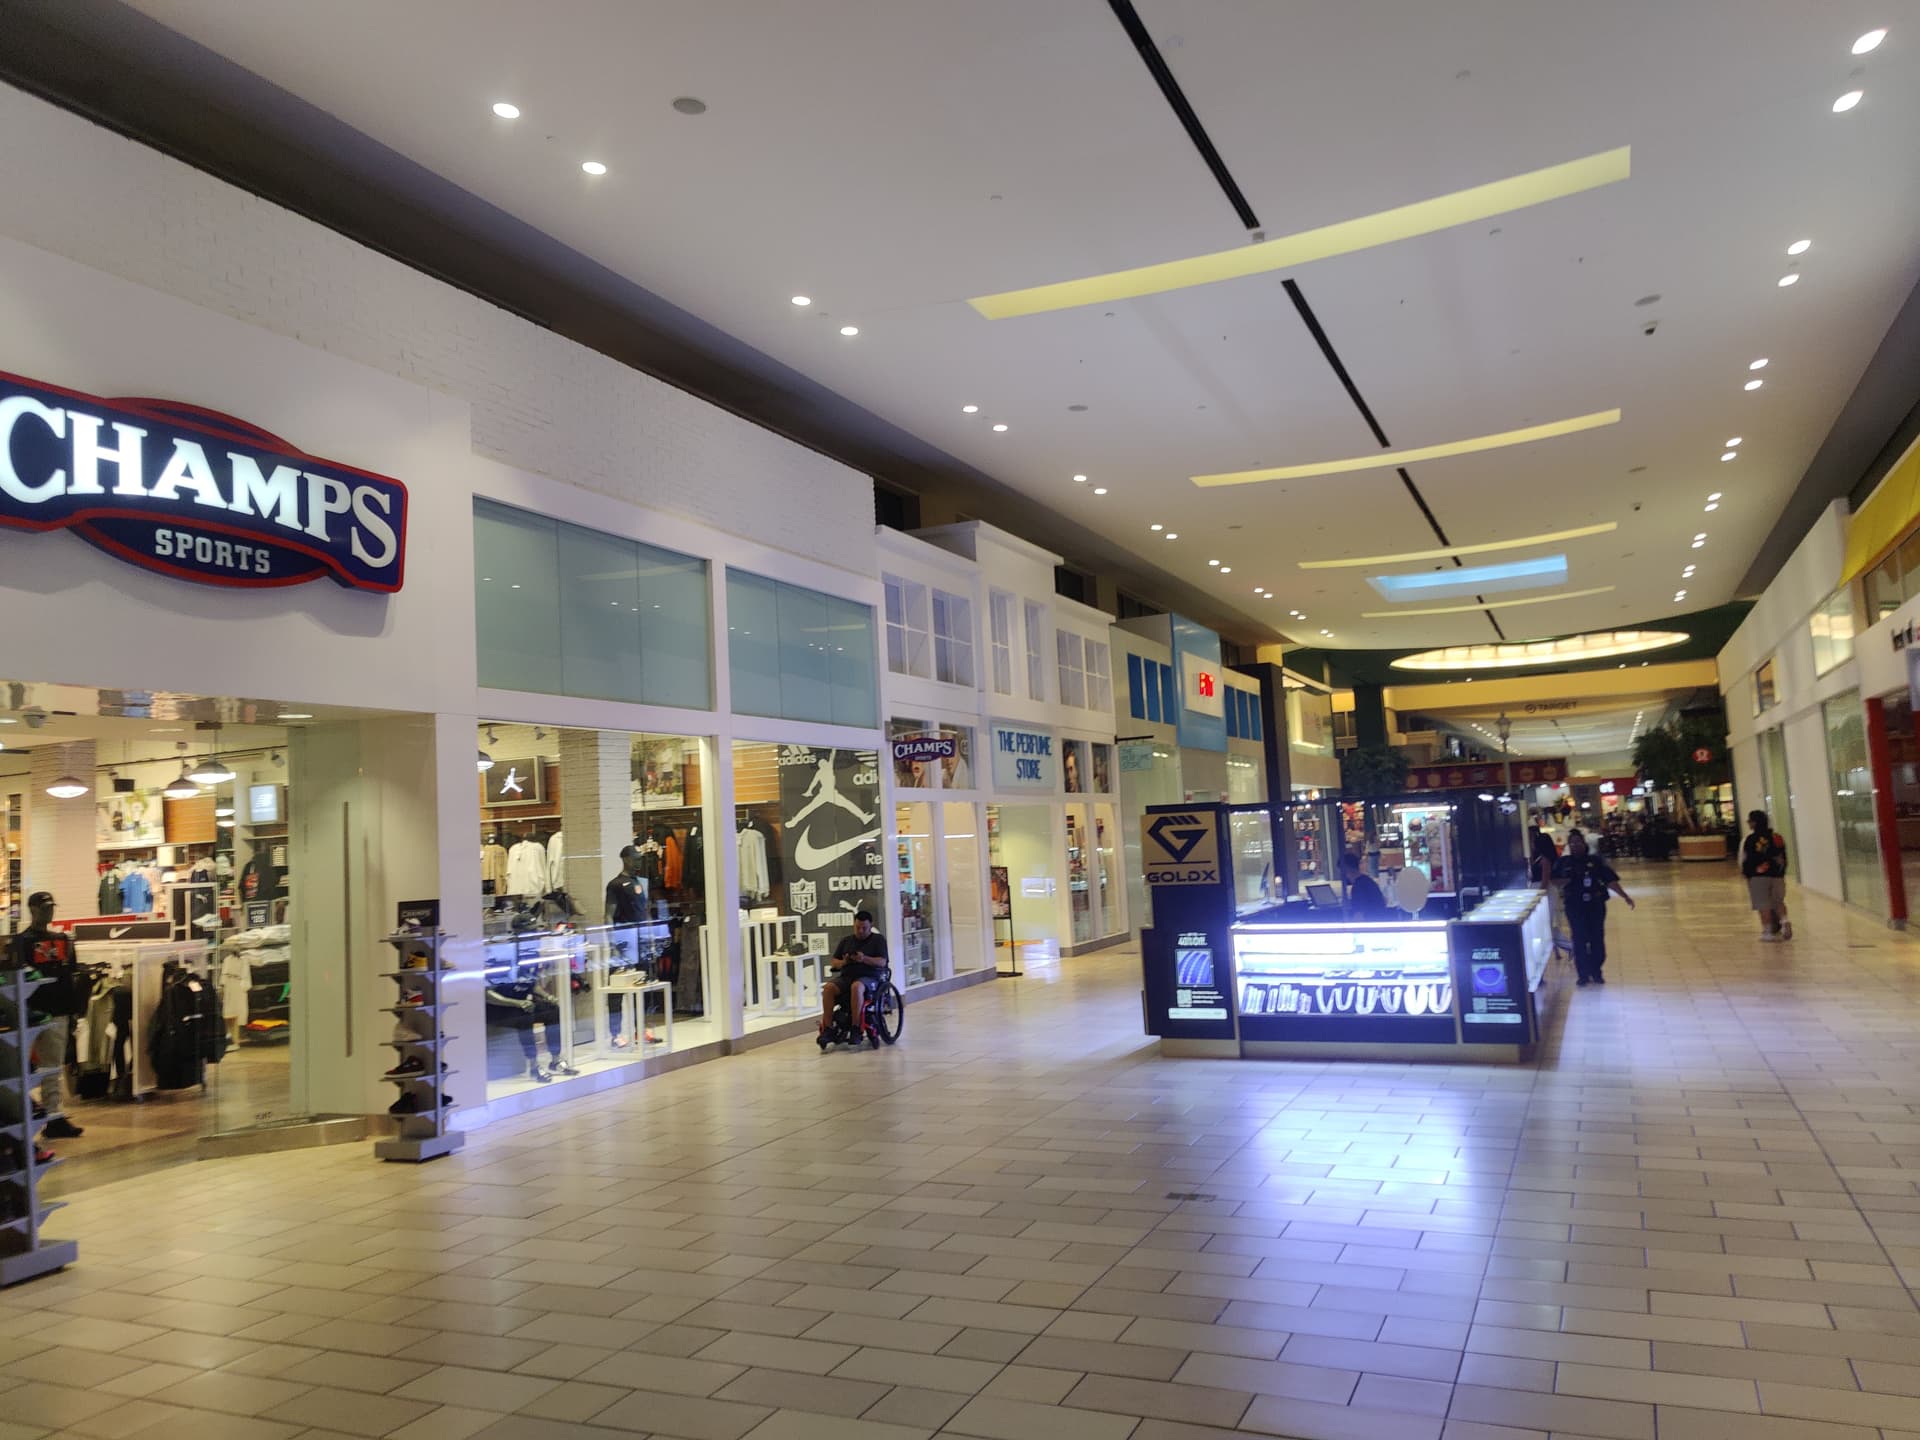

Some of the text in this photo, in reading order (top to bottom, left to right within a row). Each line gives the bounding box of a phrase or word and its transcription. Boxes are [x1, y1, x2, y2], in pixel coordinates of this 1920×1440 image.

[0, 396, 397, 568] CHAMPS
[154, 528, 271, 574] SPORTS
[894, 741, 953, 759] CHAMPS
[998, 730, 1052, 756] THE PERFUME
[1016, 758, 1042, 780] STORE
[1147, 869, 1217, 884] GOLDX
